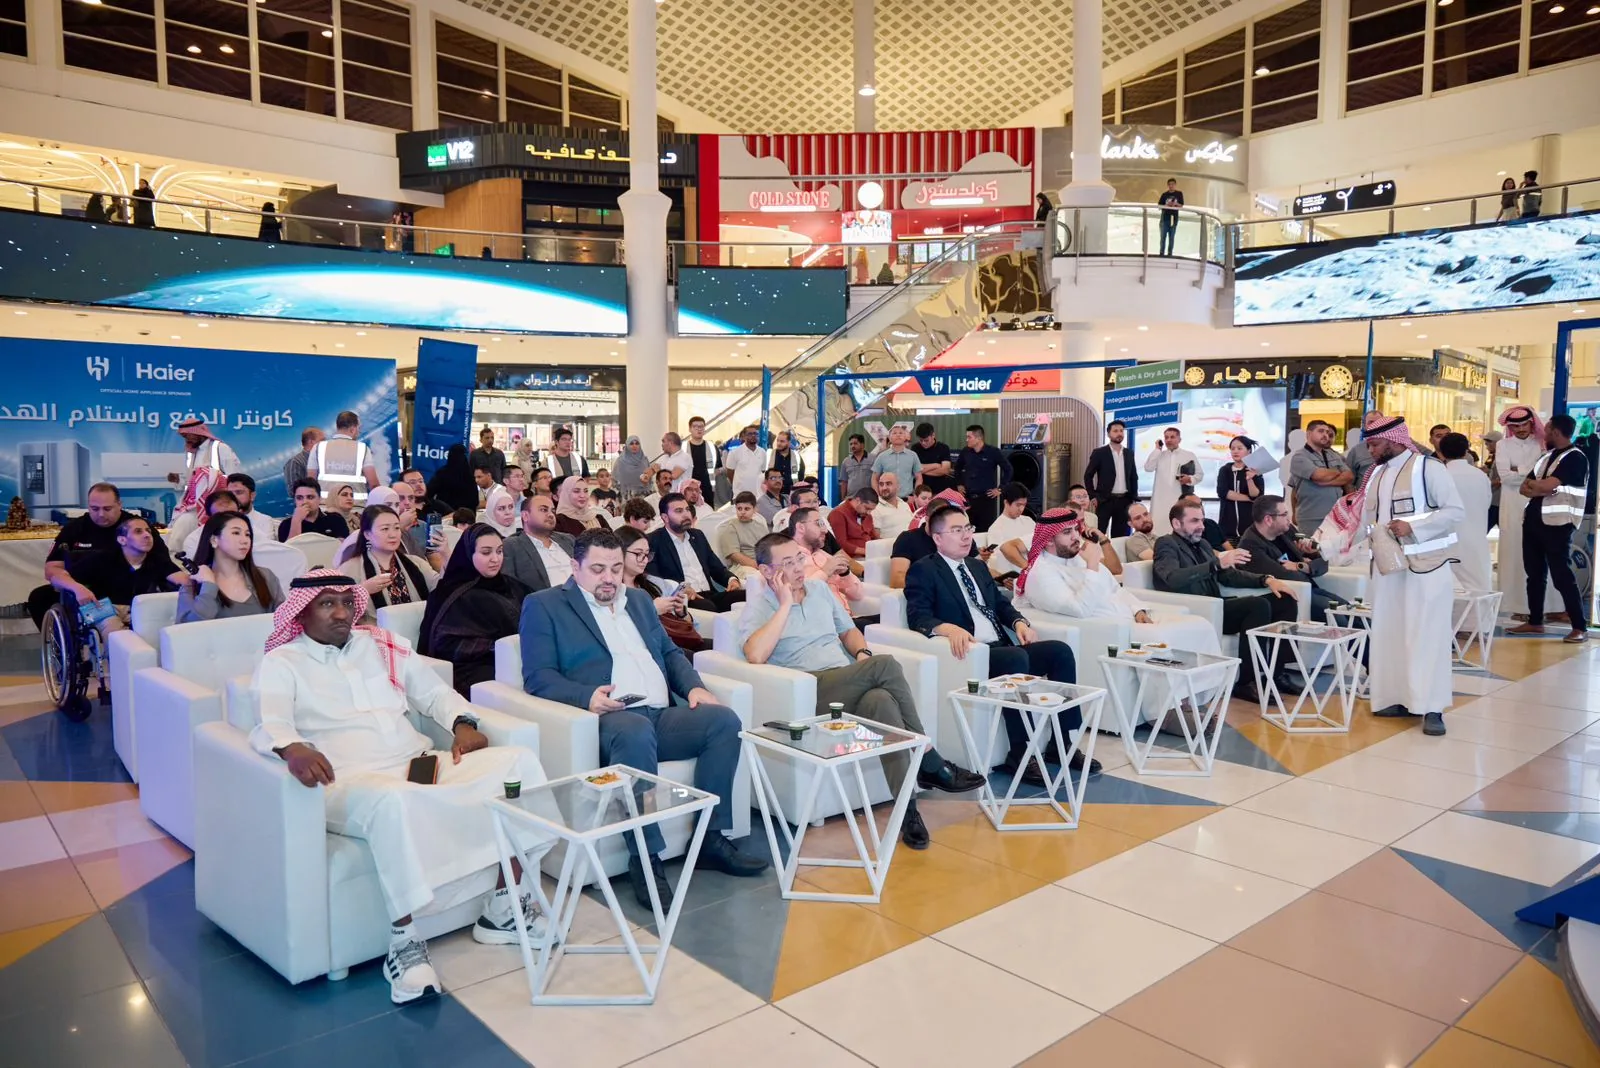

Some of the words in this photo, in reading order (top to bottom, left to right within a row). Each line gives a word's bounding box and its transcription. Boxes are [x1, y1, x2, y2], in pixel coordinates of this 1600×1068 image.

[446, 140, 475, 160] V12
[525, 143, 595, 160] كافيه
[1071, 134, 1159, 159] larks.
[1185, 141, 1238, 163] كلاركس
[749, 191, 784, 209] COLD
[786, 191, 830, 208] STONE
[136, 362, 195, 381] Haier
[523, 373, 549, 386] لوران
[1119, 374, 1137, 382] Wash
[1143, 371, 1155, 380] Dry
[550, 375, 572, 386] سان
[956, 378, 992, 391] Haier
[1105, 393, 1140, 404] Integrated
[1140, 389, 1164, 399] Design
[68, 403, 160, 428] واستلام
[233, 408, 293, 430] كاونتر
[1013, 412, 1037, 420] LAUND
[1144, 411, 1159, 419] Heat
[1159, 409, 1178, 418] Pump
